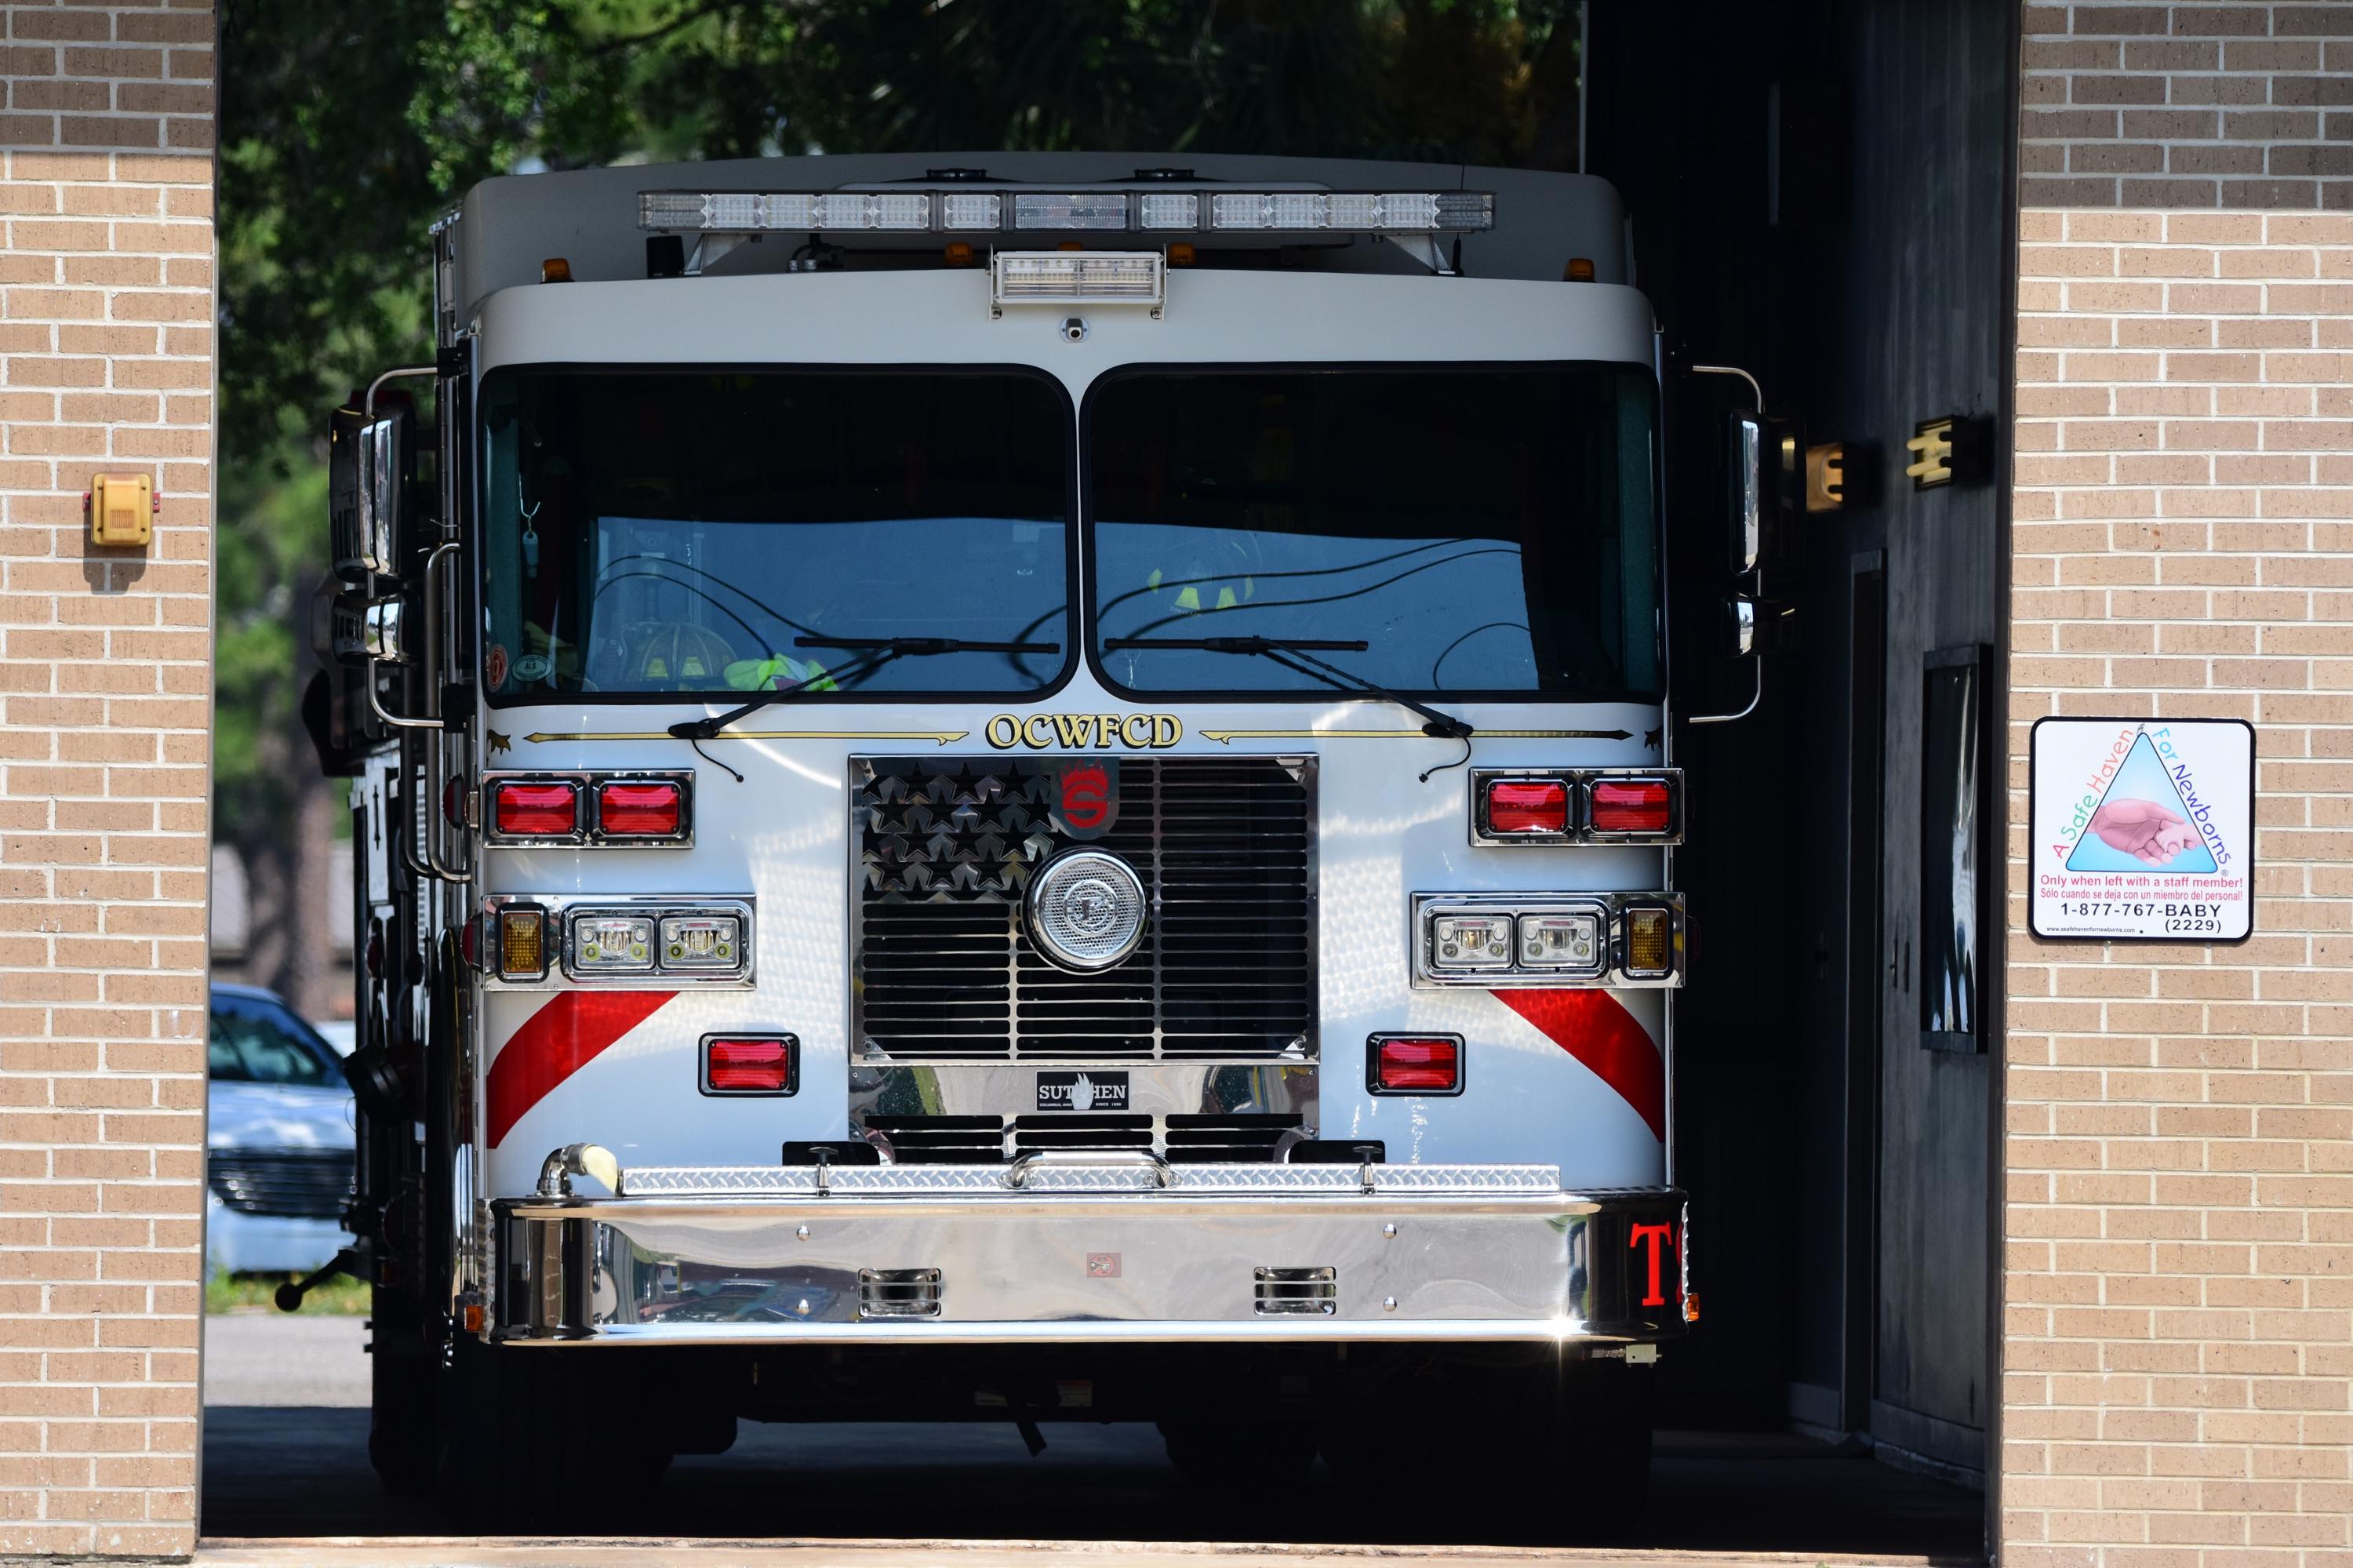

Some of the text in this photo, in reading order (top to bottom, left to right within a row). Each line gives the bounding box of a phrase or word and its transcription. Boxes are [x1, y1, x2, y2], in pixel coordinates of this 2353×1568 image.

[985, 714, 1183, 750] OCWFCD
[2053, 729, 2134, 859] A Safe Haven
[2152, 727, 2231, 864] For Newborns
[2041, 875, 2067, 888] Only
[2071, 875, 2101, 886] when
[2105, 875, 2122, 886] left
[2126, 876, 2150, 886] with
[2164, 877, 2189, 887] staff
[2193, 878, 2242, 888] member!
[2040, 887, 2059, 898] Sólo
[2061, 889, 2090, 899] cuando
[2104, 889, 2121, 901] deja
[2123, 891, 2138, 900] con
[2153, 890, 2188, 900] miembro
[2191, 891, 2202, 900] del
[2205, 891, 2242, 903] personal!
[2061, 903, 2221, 917] 1-877-767-BABY
[2166, 919, 2221, 933] (2229)
[1039, 1085, 1126, 1099] SUTHEN
